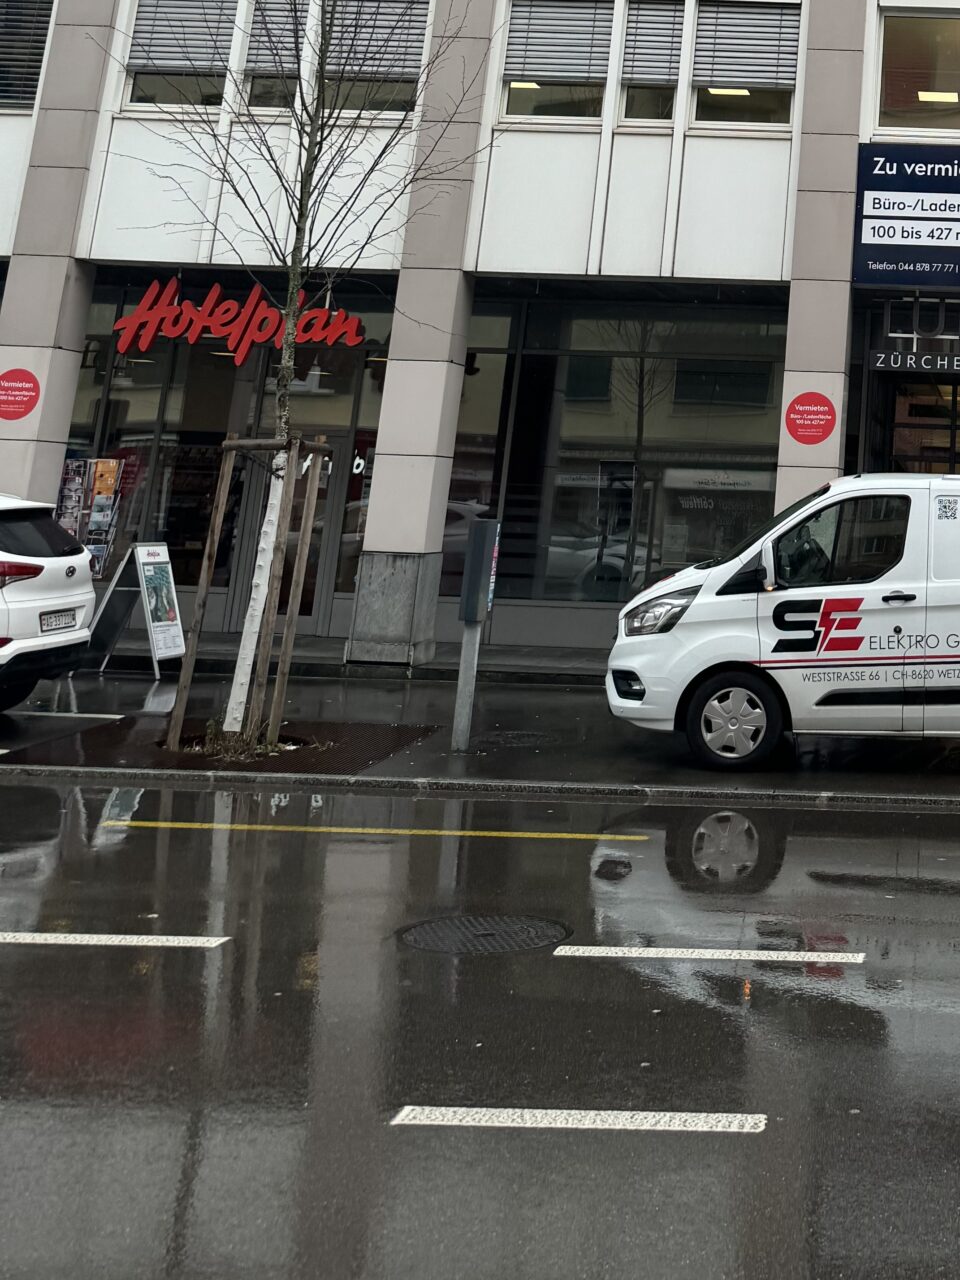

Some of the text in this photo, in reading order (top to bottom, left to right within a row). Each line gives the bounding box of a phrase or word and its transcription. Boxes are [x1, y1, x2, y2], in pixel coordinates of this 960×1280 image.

[872, 157, 897, 175] Zu
[870, 225, 896, 239] 100
[901, 226, 922, 240] bis
[926, 227, 952, 241] 427
[867, 261, 897, 271] Telefon
[898, 262, 914, 271] 044
[915, 263, 930, 272] 878
[931, 264, 942, 272] 77
[943, 264, 954, 272] 77
[0, 380, 33, 388] Vermieten
[771, 598, 865, 657] SE
[869, 634, 940, 650] ELEKTRO
[801, 671, 867, 682] WESTSTRASSE
[868, 670, 880, 681] 66
[892, 670, 935, 681] CH-8620
